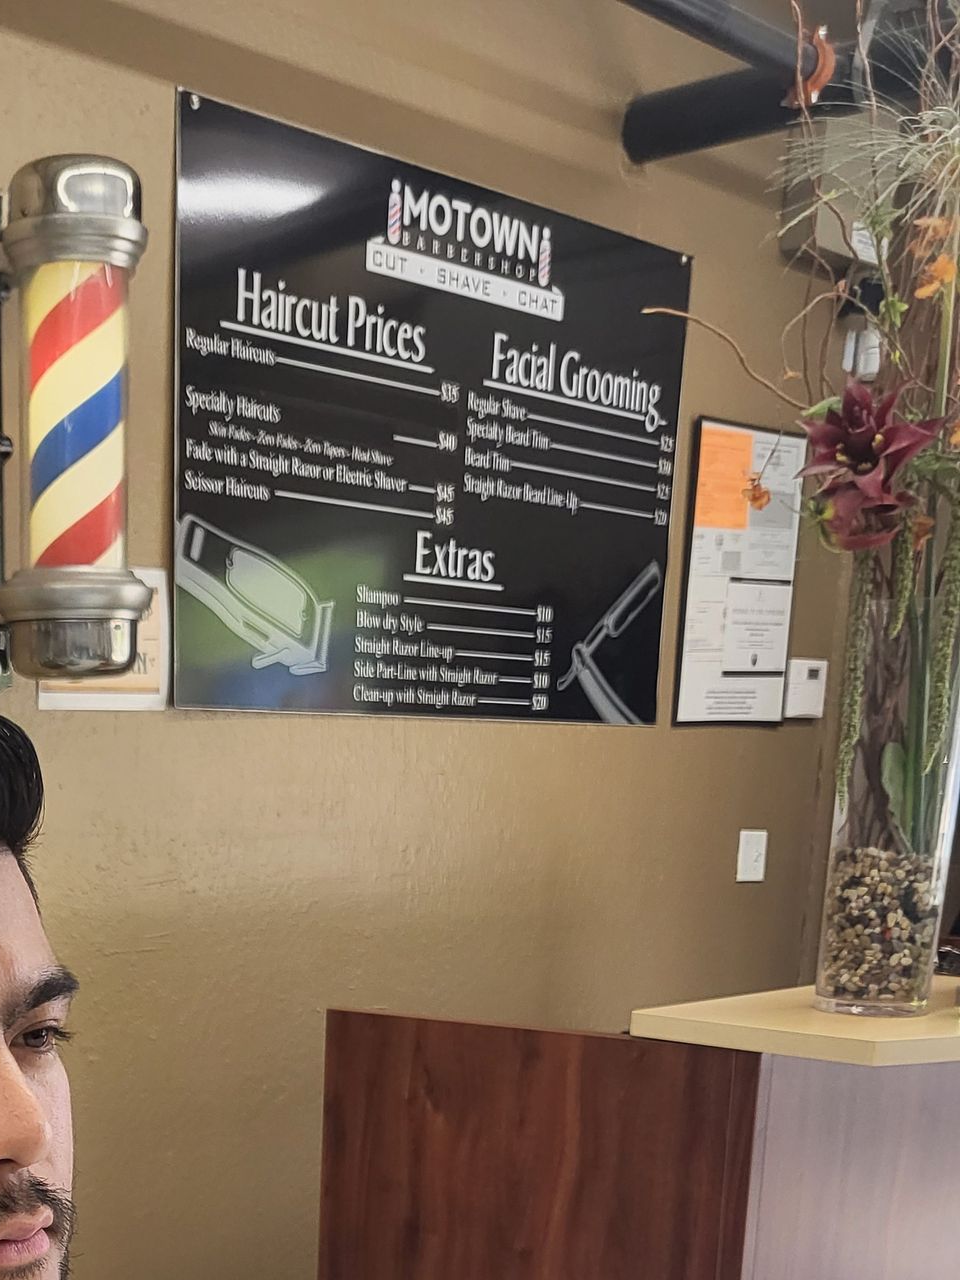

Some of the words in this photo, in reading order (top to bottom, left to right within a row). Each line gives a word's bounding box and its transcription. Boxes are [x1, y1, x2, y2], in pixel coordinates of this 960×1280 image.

[403, 183, 539, 264] MOTOWN
[402, 231, 536, 282] BARBERSHOP
[372, 250, 407, 271] CUT
[437, 268, 491, 297] SHAVE
[517, 290, 558, 313] CHAT
[236, 268, 340, 344] Haircut
[346, 296, 427, 363] Prices
[185, 327, 230, 356] Regular
[231, 337, 277, 366] Haircuts
[491, 332, 557, 392] Facial
[559, 350, 668, 433] Grooming
[185, 384, 236, 422] Specialty
[237, 395, 281, 424] Haircuts
[467, 389, 501, 419] Regular
[501, 397, 527, 422] Shave
[466, 416, 504, 448] Specialty
[505, 423, 531, 447] Beard
[531, 428, 551, 450] Trim
[185, 438, 213, 461] Fade
[214, 444, 239, 466] with
[240, 452, 248, 468] a
[248, 448, 291, 477] Straight
[291, 456, 323, 479] Razor
[322, 466, 335, 481] or
[335, 464, 373, 488] Electric
[373, 469, 408, 493] Shaver
[464, 445, 491, 470] Beard
[491, 450, 512, 472] Trim
[184, 469, 225, 494] Scissor
[225, 475, 271, 501] Haircuts
[463, 472, 495, 502] Straight
[496, 477, 522, 500] Razor
[523, 482, 546, 505] Beard
[415, 530, 495, 581] Extras
[356, 584, 400, 609] Shampoo
[536, 604, 554, 622] $10
[356, 609, 380, 629] Blow
[381, 610, 398, 635] dry
[400, 613, 424, 636] Style
[536, 625, 552, 644] $15
[354, 635, 390, 658] Straight
[392, 638, 419, 657] Razor
[420, 639, 454, 664] Line-up
[534, 648, 551, 667] $15
[353, 659, 376, 679] Side
[418, 662, 438, 682] with
[439, 664, 472, 687] Straight
[473, 666, 499, 686] Razor
[353, 683, 394, 707] Clean-up
[395, 685, 416, 705] with
[416, 685, 450, 709] Straight
[451, 688, 477, 707] Razor
